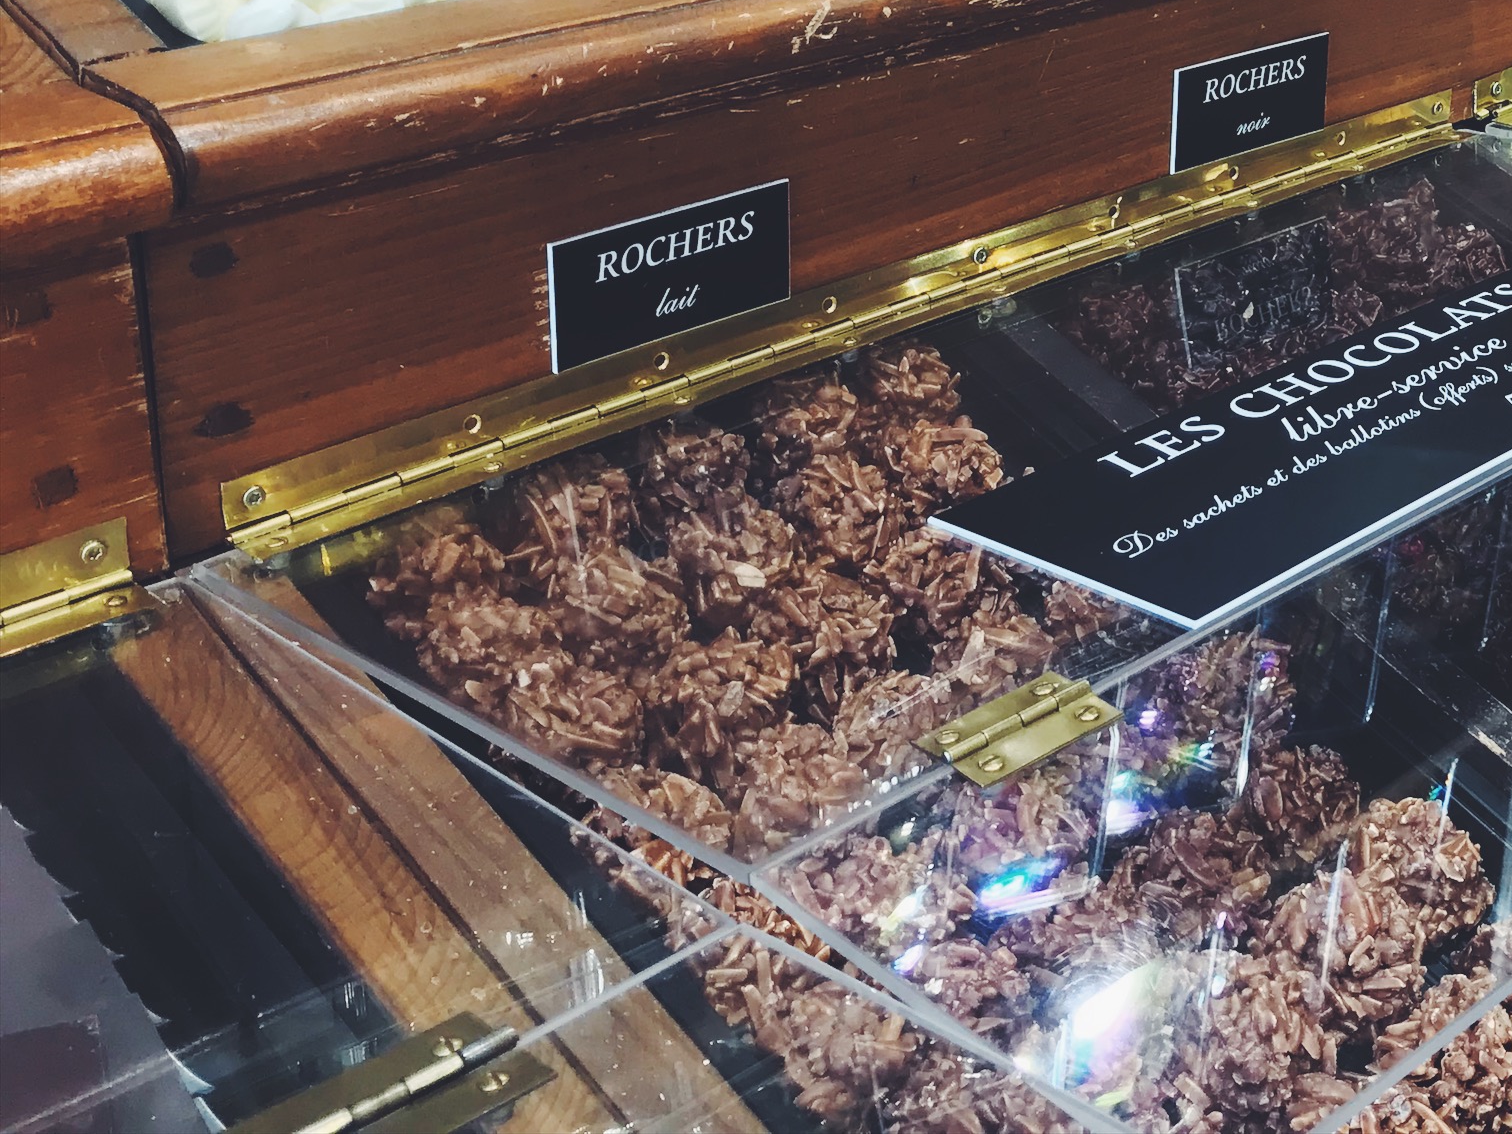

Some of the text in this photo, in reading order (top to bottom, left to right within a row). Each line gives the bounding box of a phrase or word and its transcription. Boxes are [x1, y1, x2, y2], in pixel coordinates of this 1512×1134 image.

[1202, 55, 1307, 104] ROCHERS
[1236, 112, 1270, 136] noir
[595, 210, 755, 284] ROCHERS
[655, 284, 700, 318] lait
[1280, 337, 1507, 442] libre-service
[1097, 415, 1226, 478] LES
[1112, 529, 1179, 559] Des
[1183, 484, 1263, 530] sachets
[1267, 468, 1289, 487] et
[1292, 452, 1328, 475] des
[1324, 408, 1421, 456] ballotins
[1419, 366, 1500, 411] (offerts)
